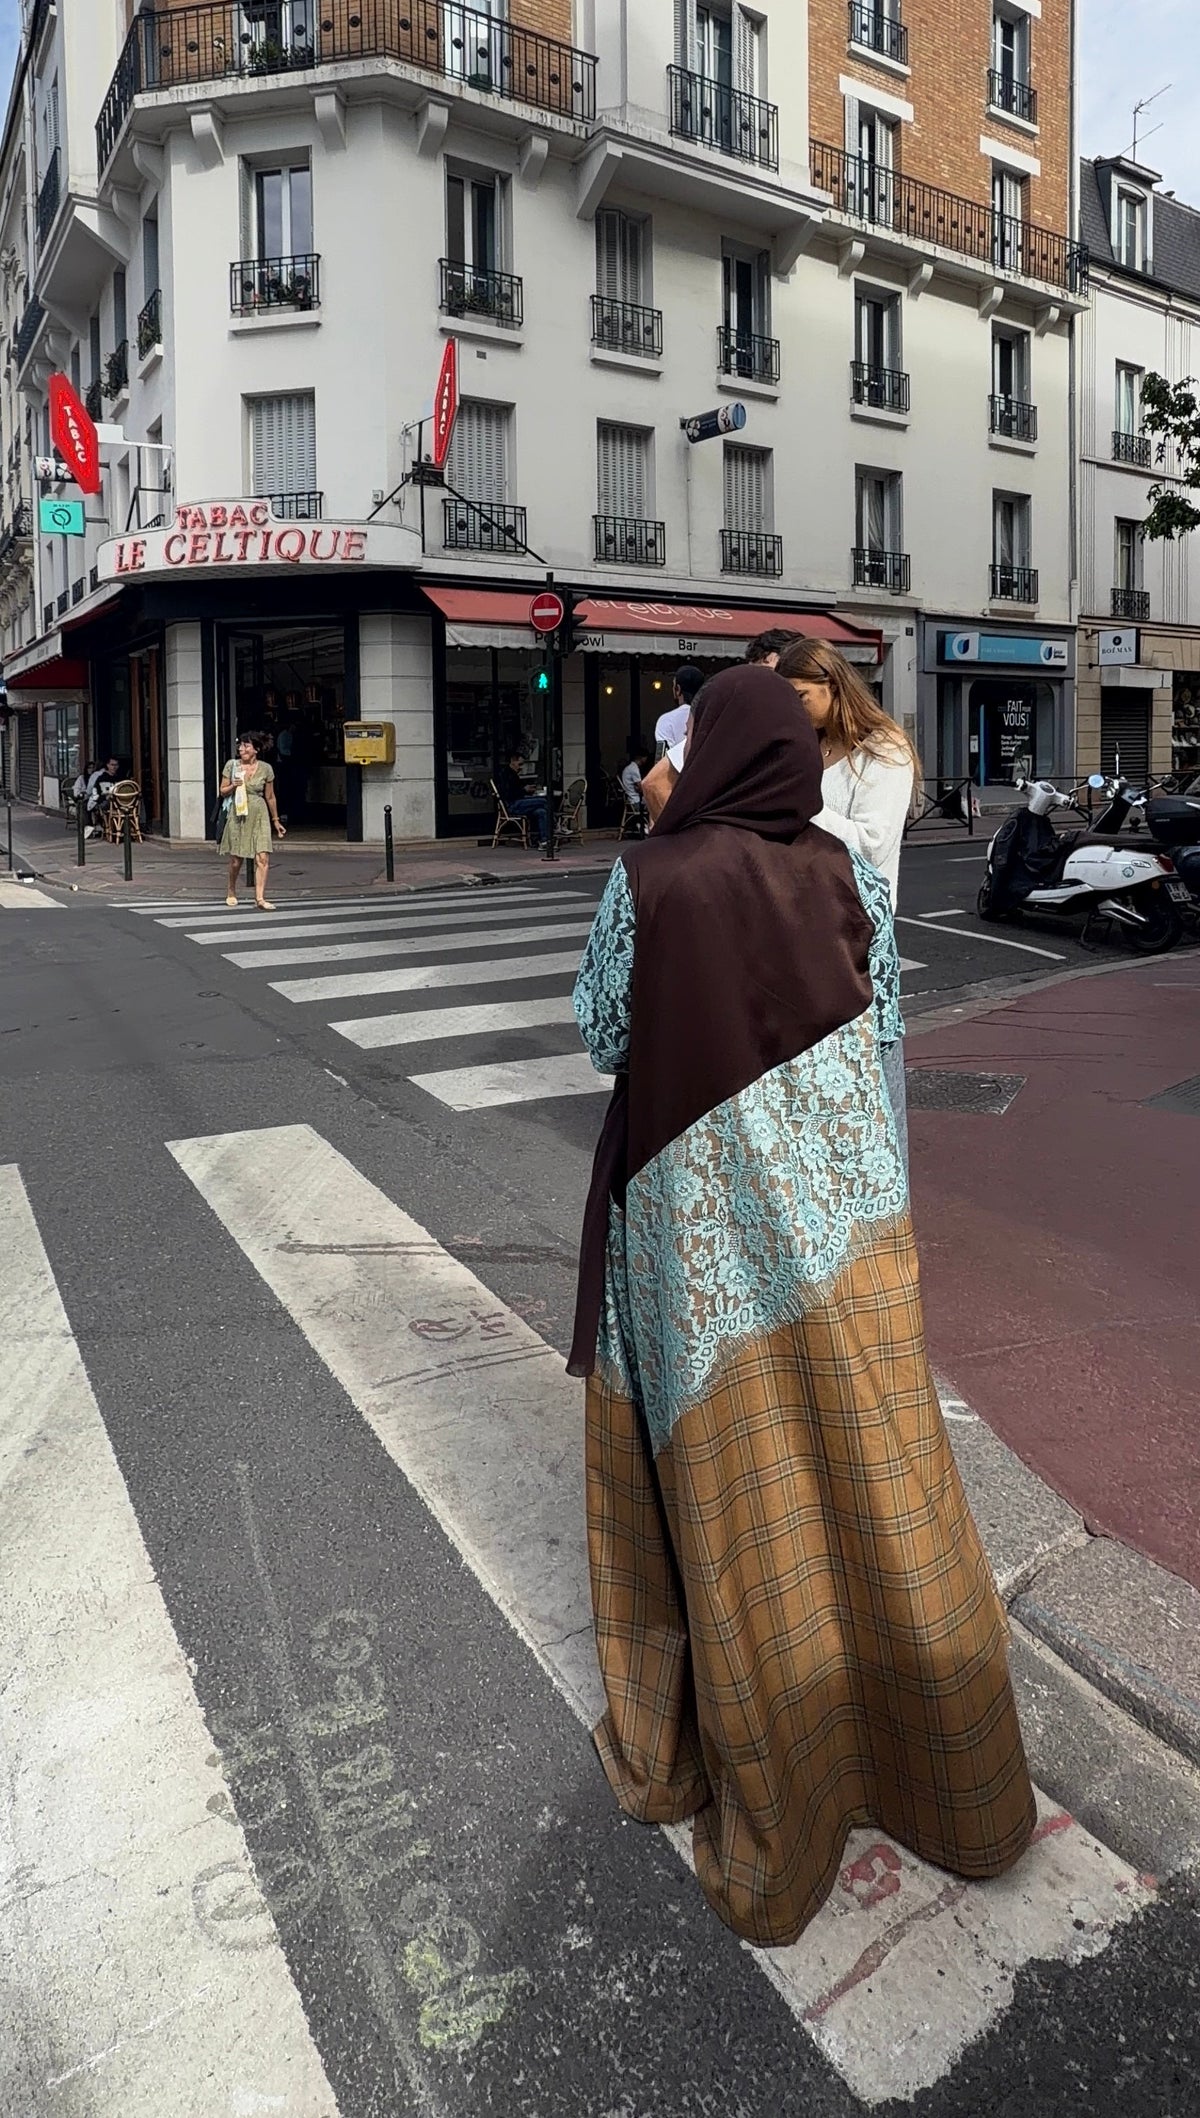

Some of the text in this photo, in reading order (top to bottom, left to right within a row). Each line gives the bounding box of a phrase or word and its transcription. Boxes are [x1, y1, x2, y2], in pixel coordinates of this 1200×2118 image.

[440, 373, 450, 435] TABAC
[63, 405, 87, 463] TABAC
[176, 504, 269, 530] TABAC
[114, 528, 368, 573] LE CELTIQUE
[678, 638, 698, 651] Bar
[1007, 700, 1023, 712] FAIT
